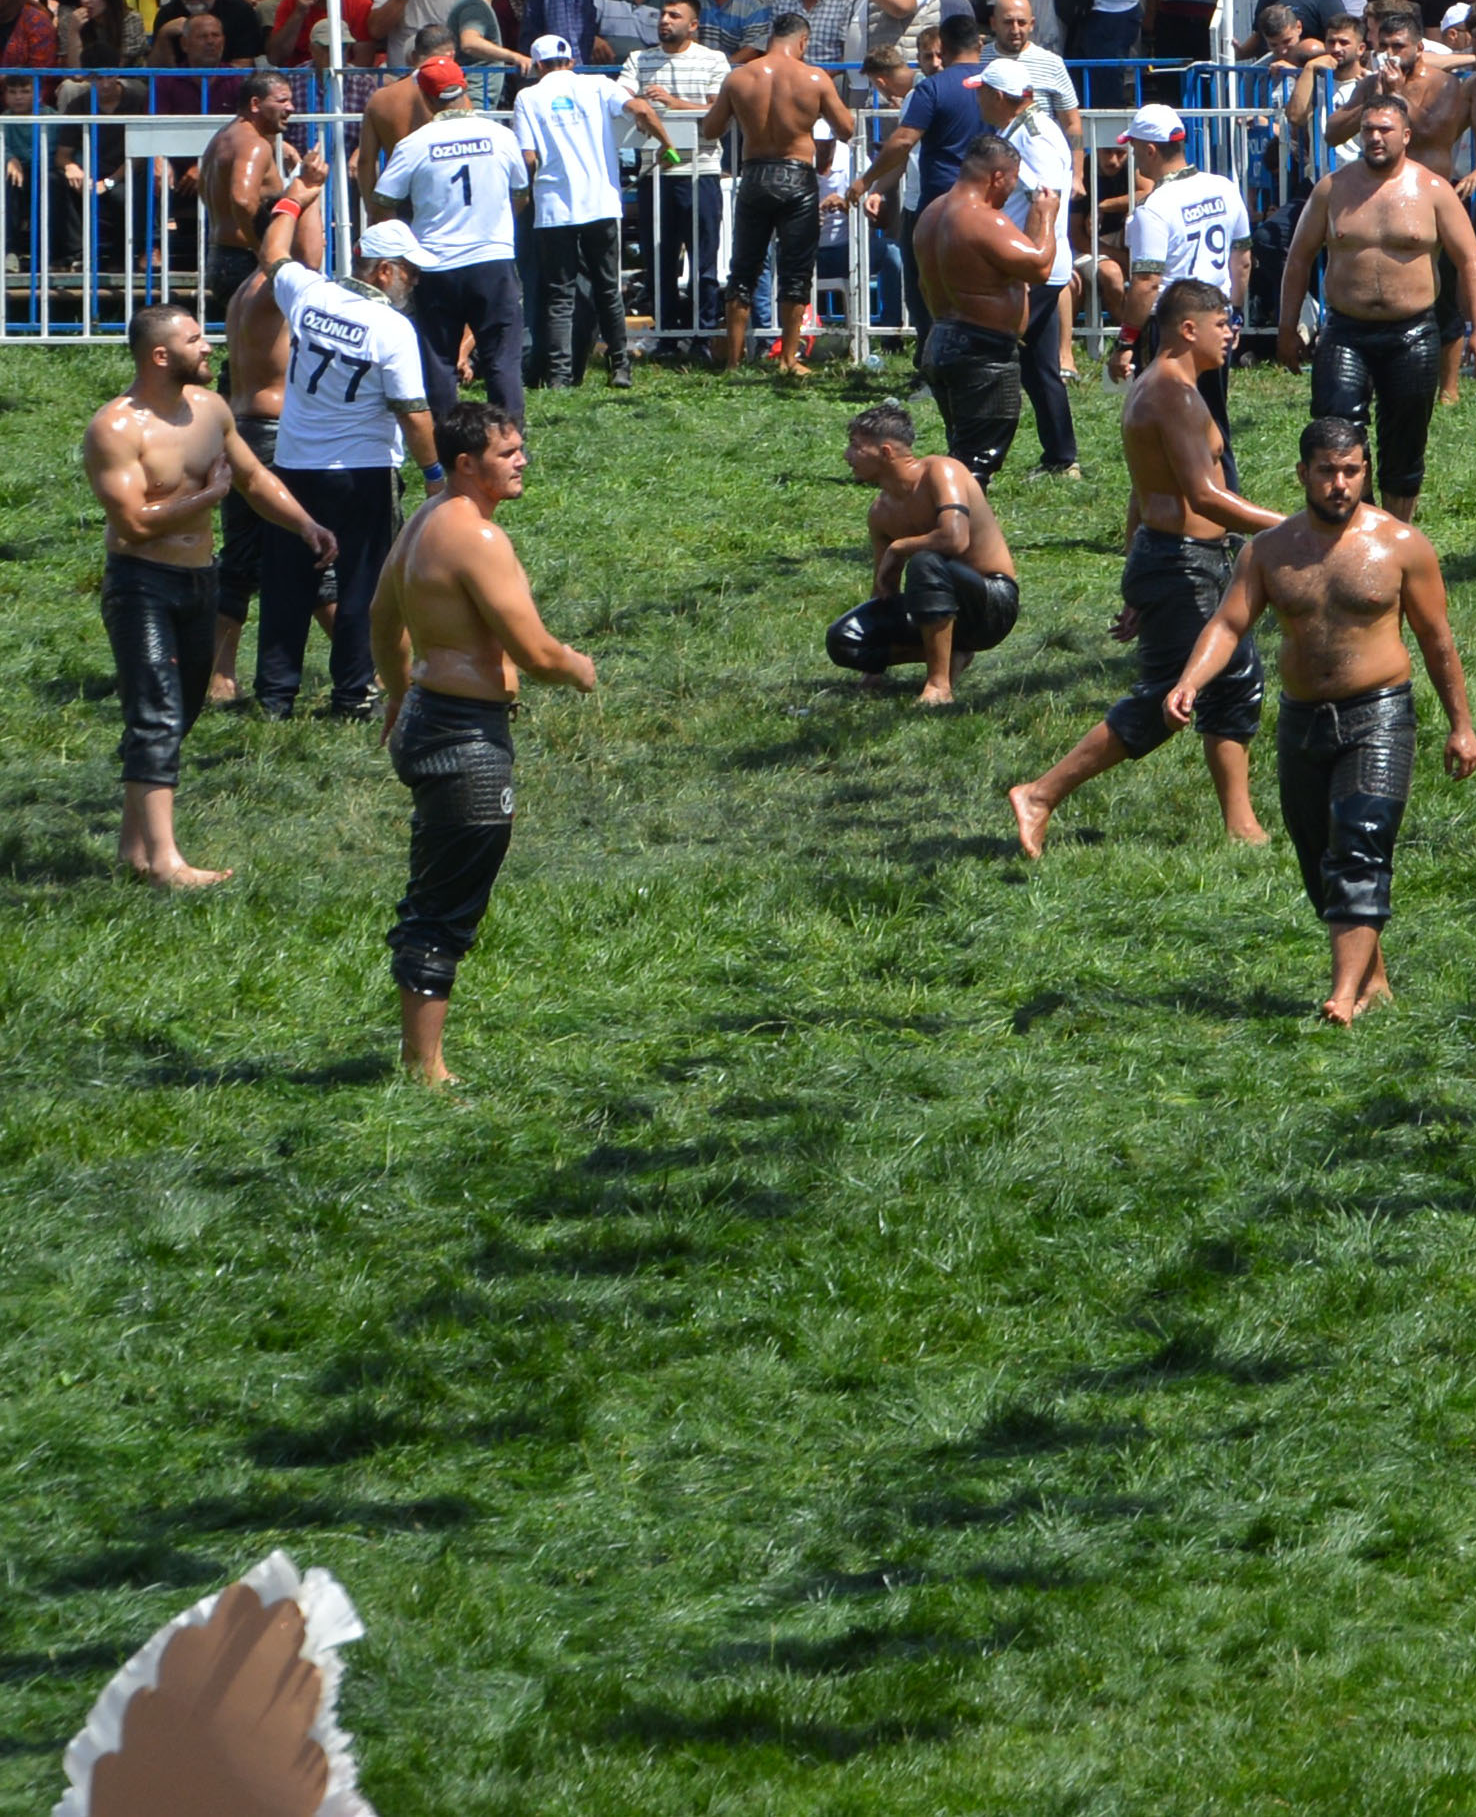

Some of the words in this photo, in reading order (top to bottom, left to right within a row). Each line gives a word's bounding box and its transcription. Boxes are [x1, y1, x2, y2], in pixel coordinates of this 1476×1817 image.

[431, 139, 492, 159] ÖZÜNLÜ
[450, 164, 473, 207] 1
[1186, 223, 1226, 276] 79
[302, 308, 367, 344] ÖZÜNLÜ
